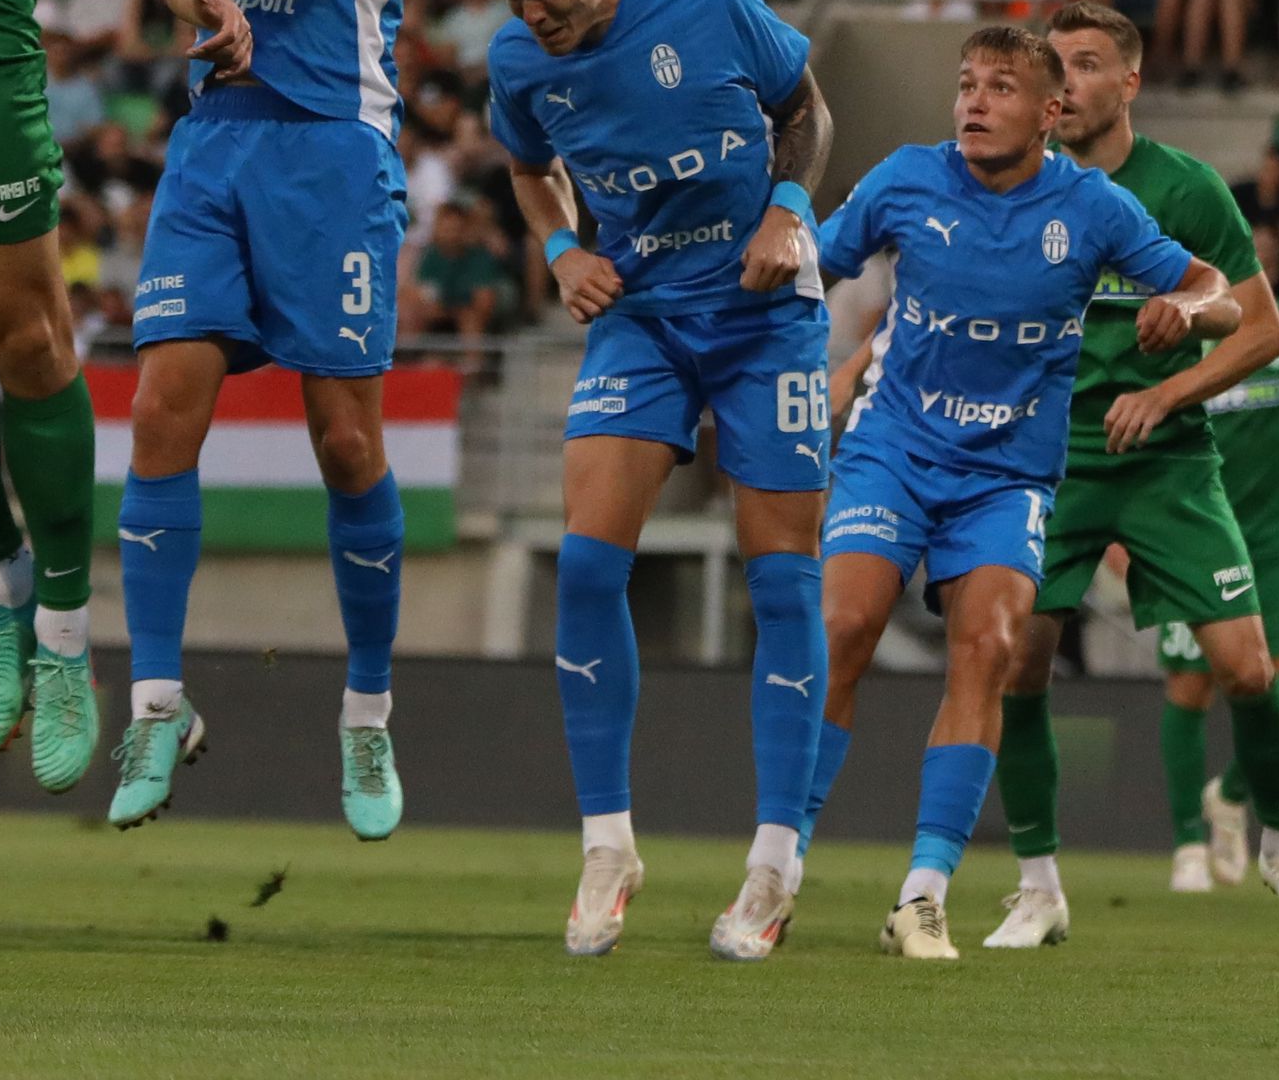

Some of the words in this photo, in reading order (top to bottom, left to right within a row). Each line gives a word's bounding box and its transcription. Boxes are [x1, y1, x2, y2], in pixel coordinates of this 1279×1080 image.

[152, 274, 185, 291] TIRE
[341, 251, 372, 316] 3
[597, 375, 629, 391] TIRE
[601, 399, 624, 412] PRO
[777, 370, 829, 434] 66
